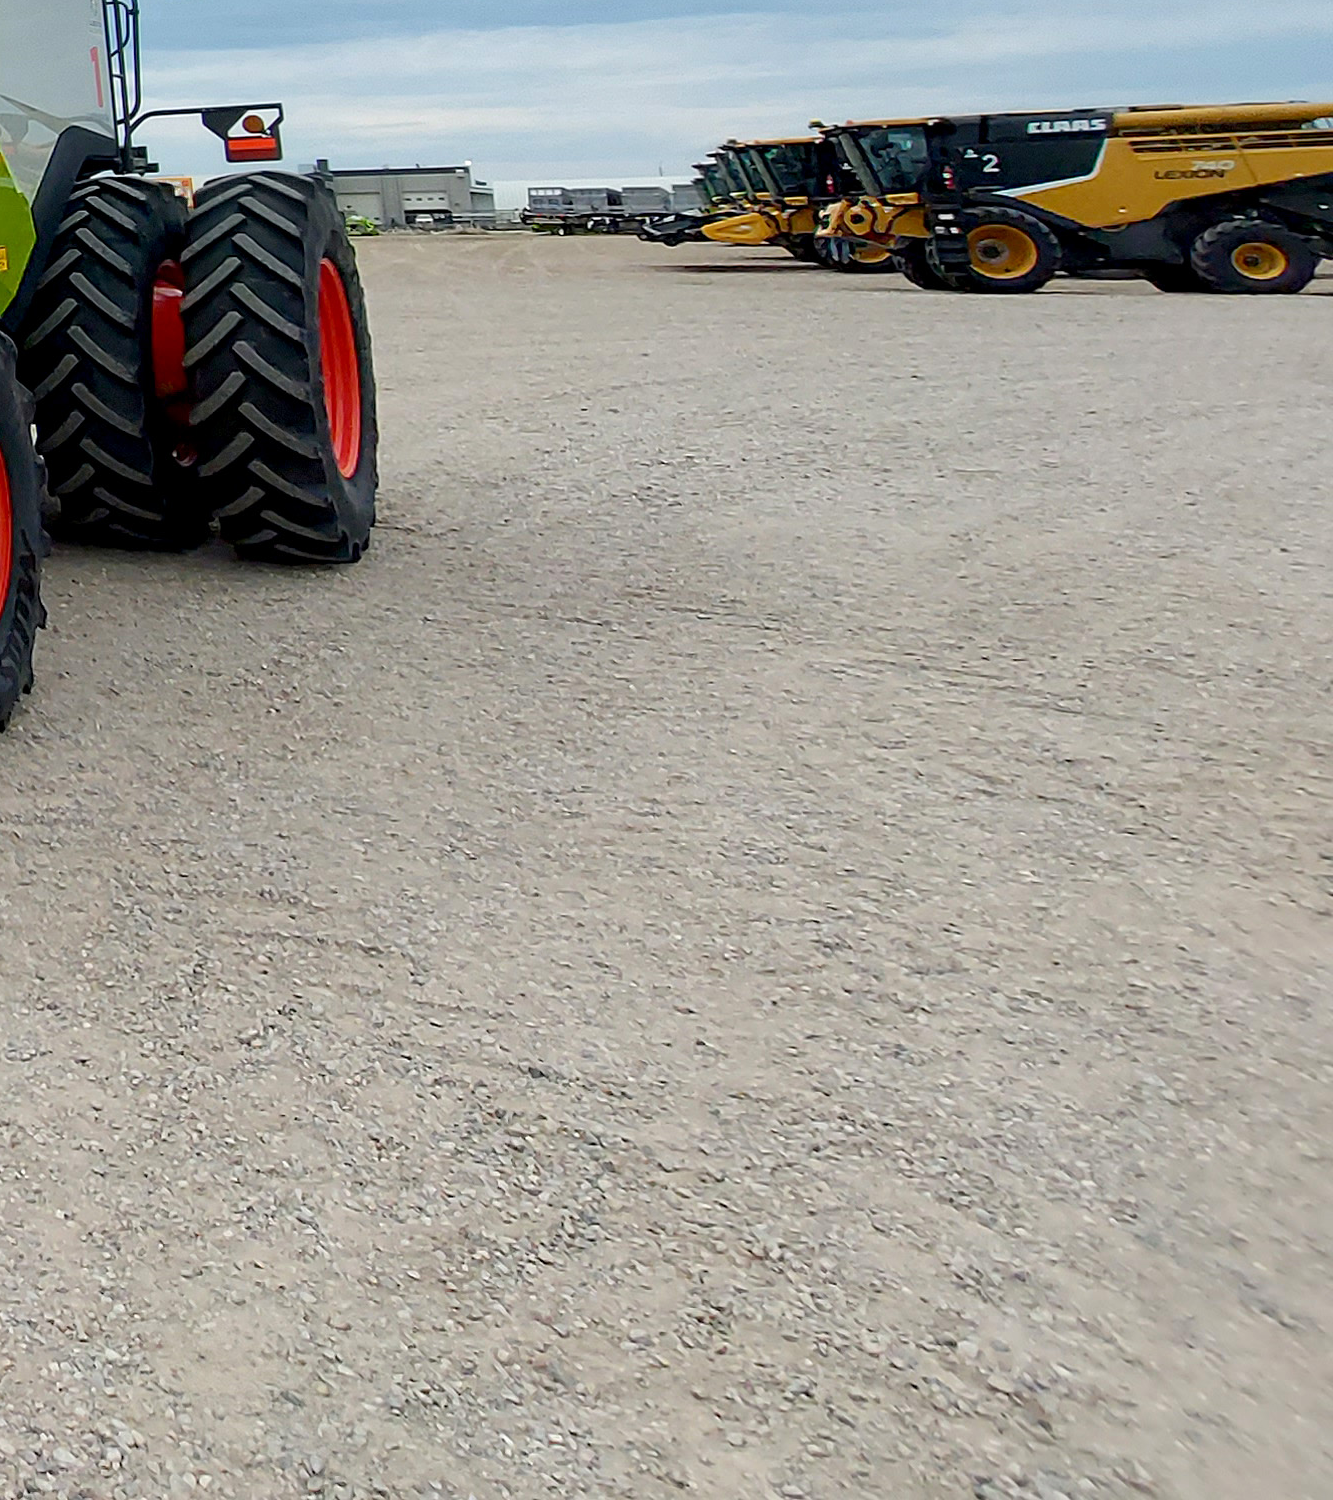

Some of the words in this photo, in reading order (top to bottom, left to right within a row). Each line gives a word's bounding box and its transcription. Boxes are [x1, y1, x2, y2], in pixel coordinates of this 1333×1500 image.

[90, 46, 104, 108] 1
[1026, 119, 1107, 134] CLAAS
[982, 154, 1000, 172] 2
